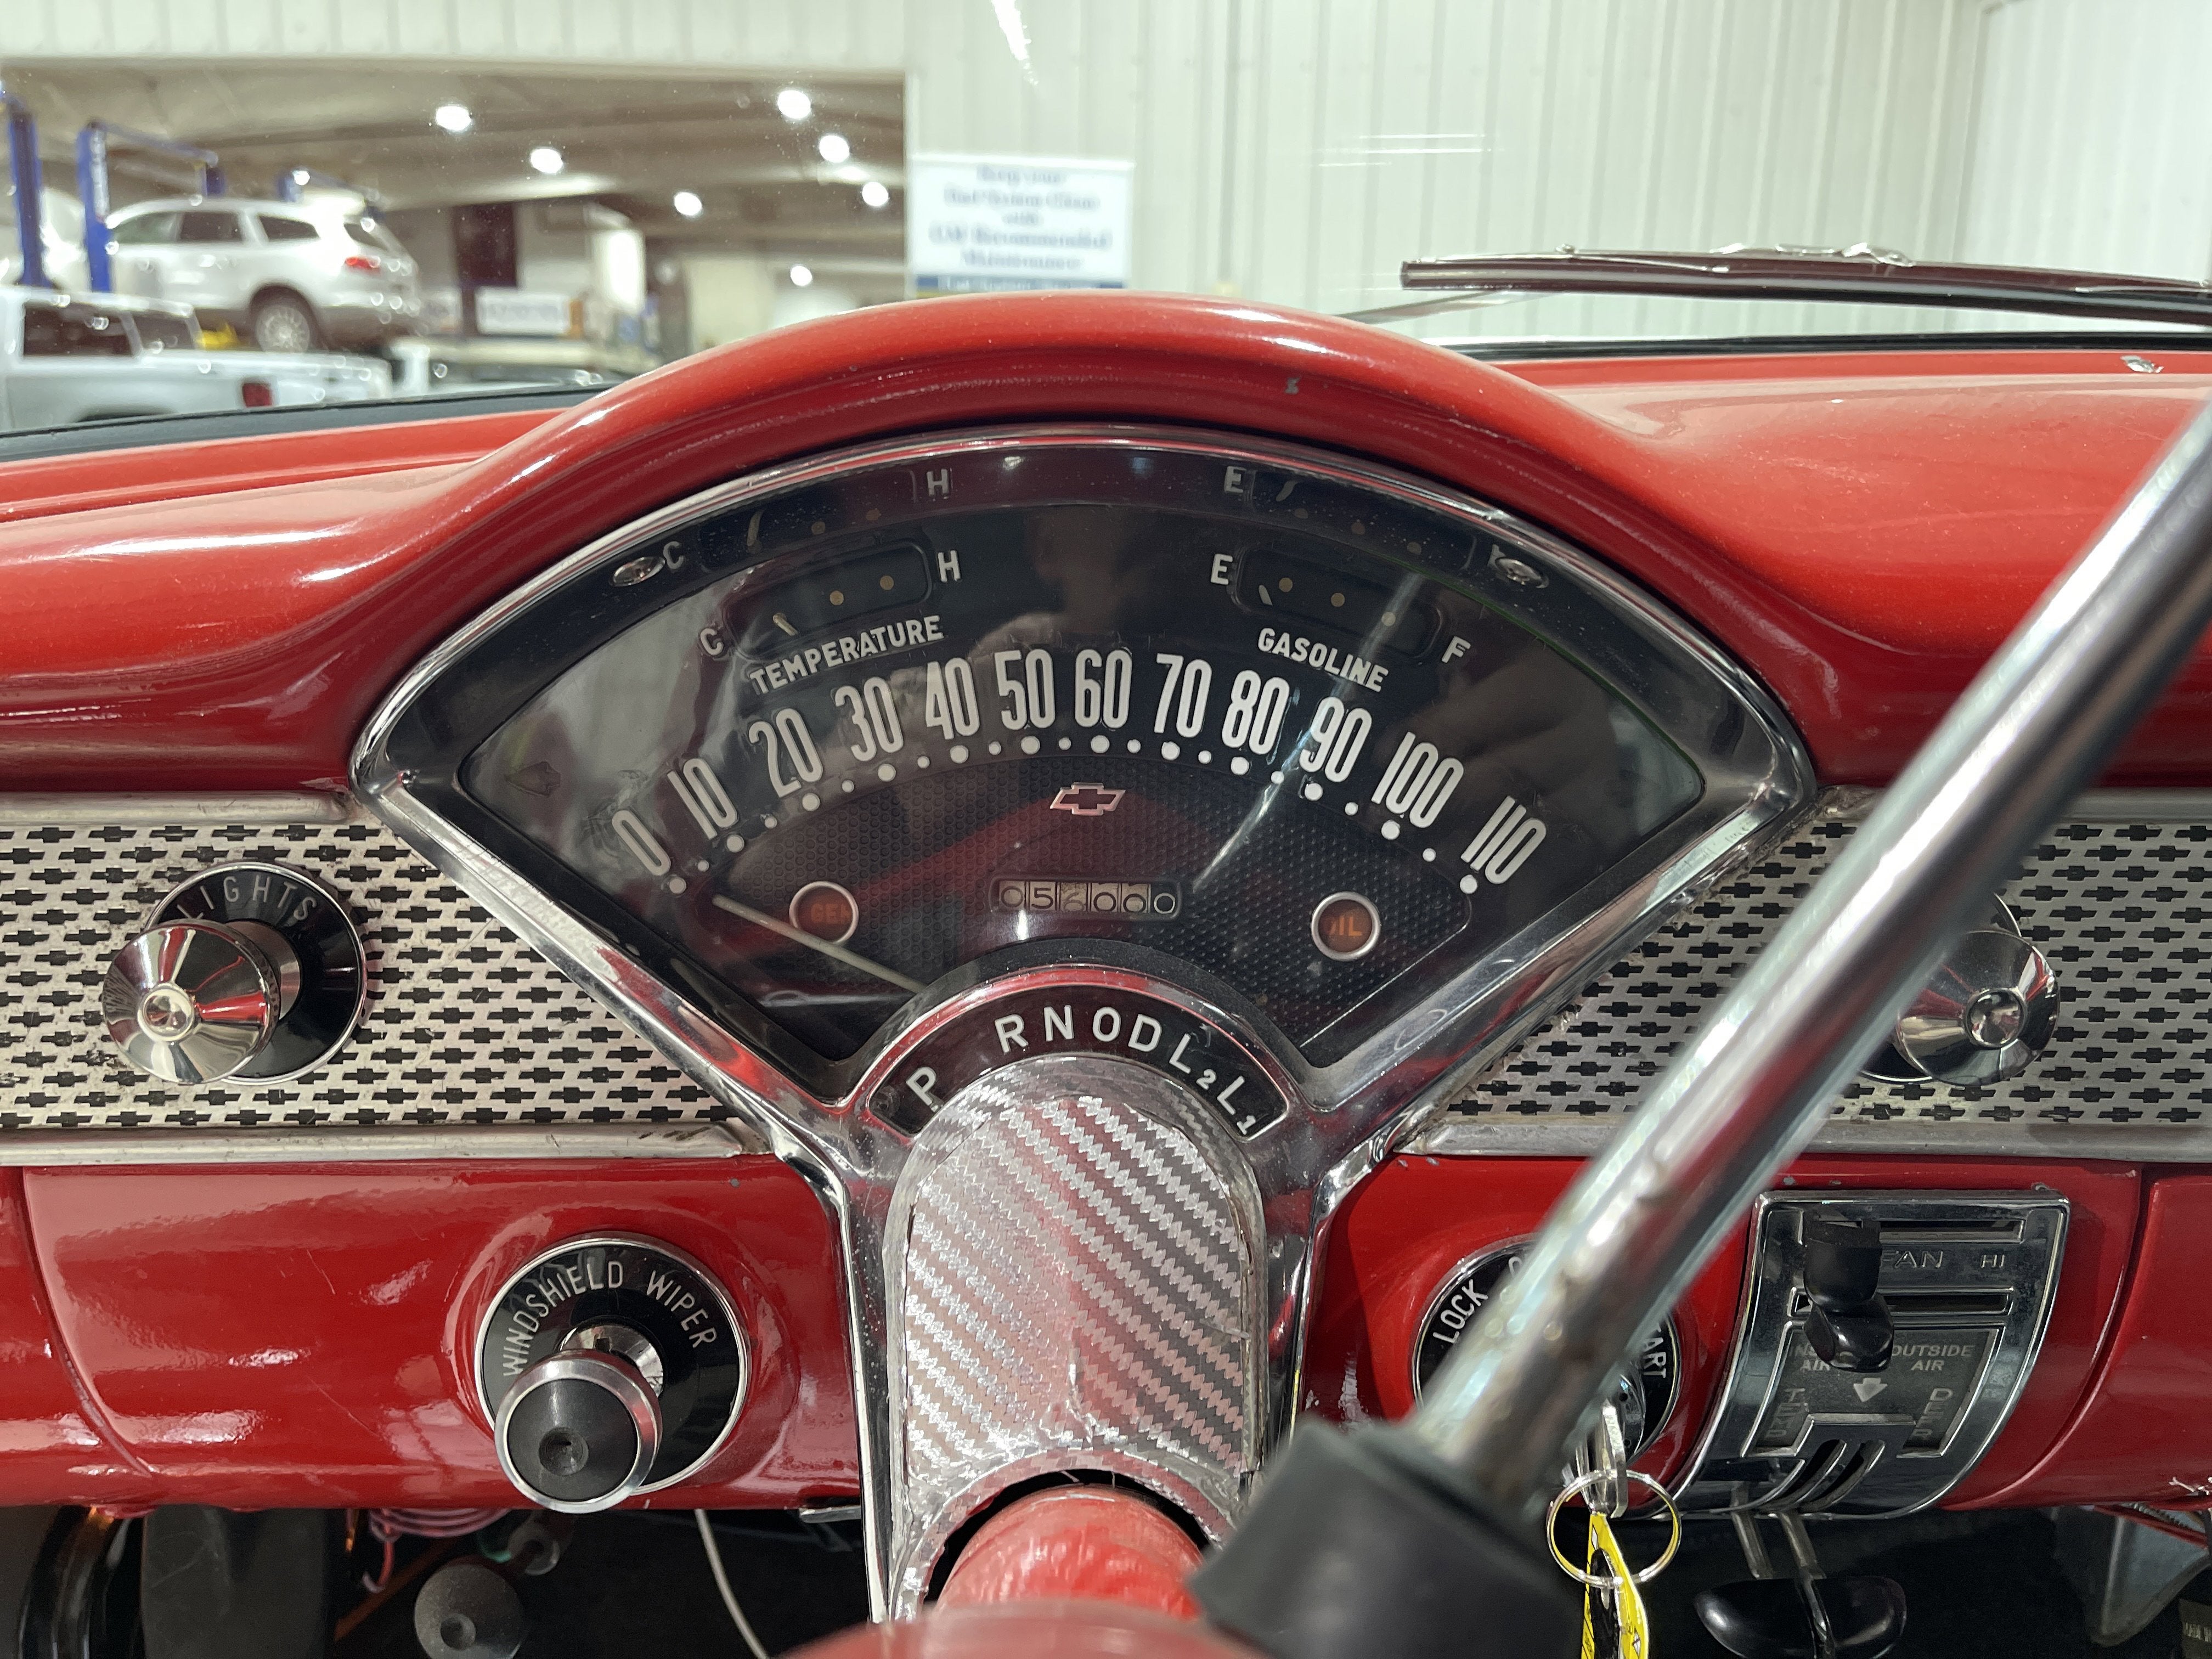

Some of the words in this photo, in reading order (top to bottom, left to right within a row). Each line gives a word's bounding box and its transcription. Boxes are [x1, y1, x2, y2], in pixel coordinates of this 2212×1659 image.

[938, 550, 962, 582] H
[1210, 554, 1233, 585] E
[699, 627, 724, 656] C
[749, 615, 944, 695] TEMPERATURE
[1257, 628, 1389, 692] GASOLINE
[1441, 636, 1471, 663] F
[612, 810, 670, 875] 0
[667, 758, 737, 840] 10
[748, 708, 823, 798] 20
[835, 676, 904, 761] 30
[925, 658, 980, 740] 40
[994, 648, 1056, 730] 50
[1075, 648, 1132, 729] 60
[1154, 653, 1212, 738] 70
[1222, 670, 1290, 754] 80
[1299, 697, 1372, 782] 90
[1371, 731, 1464, 828] 100
[1460, 795, 1547, 884] 110
[177, 876, 317, 920] LIGHTS
[906, 1066, 939, 1110] P
[994, 1013, 1029, 1053] R
[1043, 1005, 1074, 1041] N
[1128, 1014, 1162, 1052] D
[1980, 1254, 2005, 1268] HI
[503, 1261, 624, 1376] WINDSHIELD
[646, 1271, 717, 1348] WIPER
[1432, 1279, 1488, 1343] LOCK
[1891, 1344, 1975, 1357] OUTSIDE
[1911, 1359, 1945, 1371] AIR
